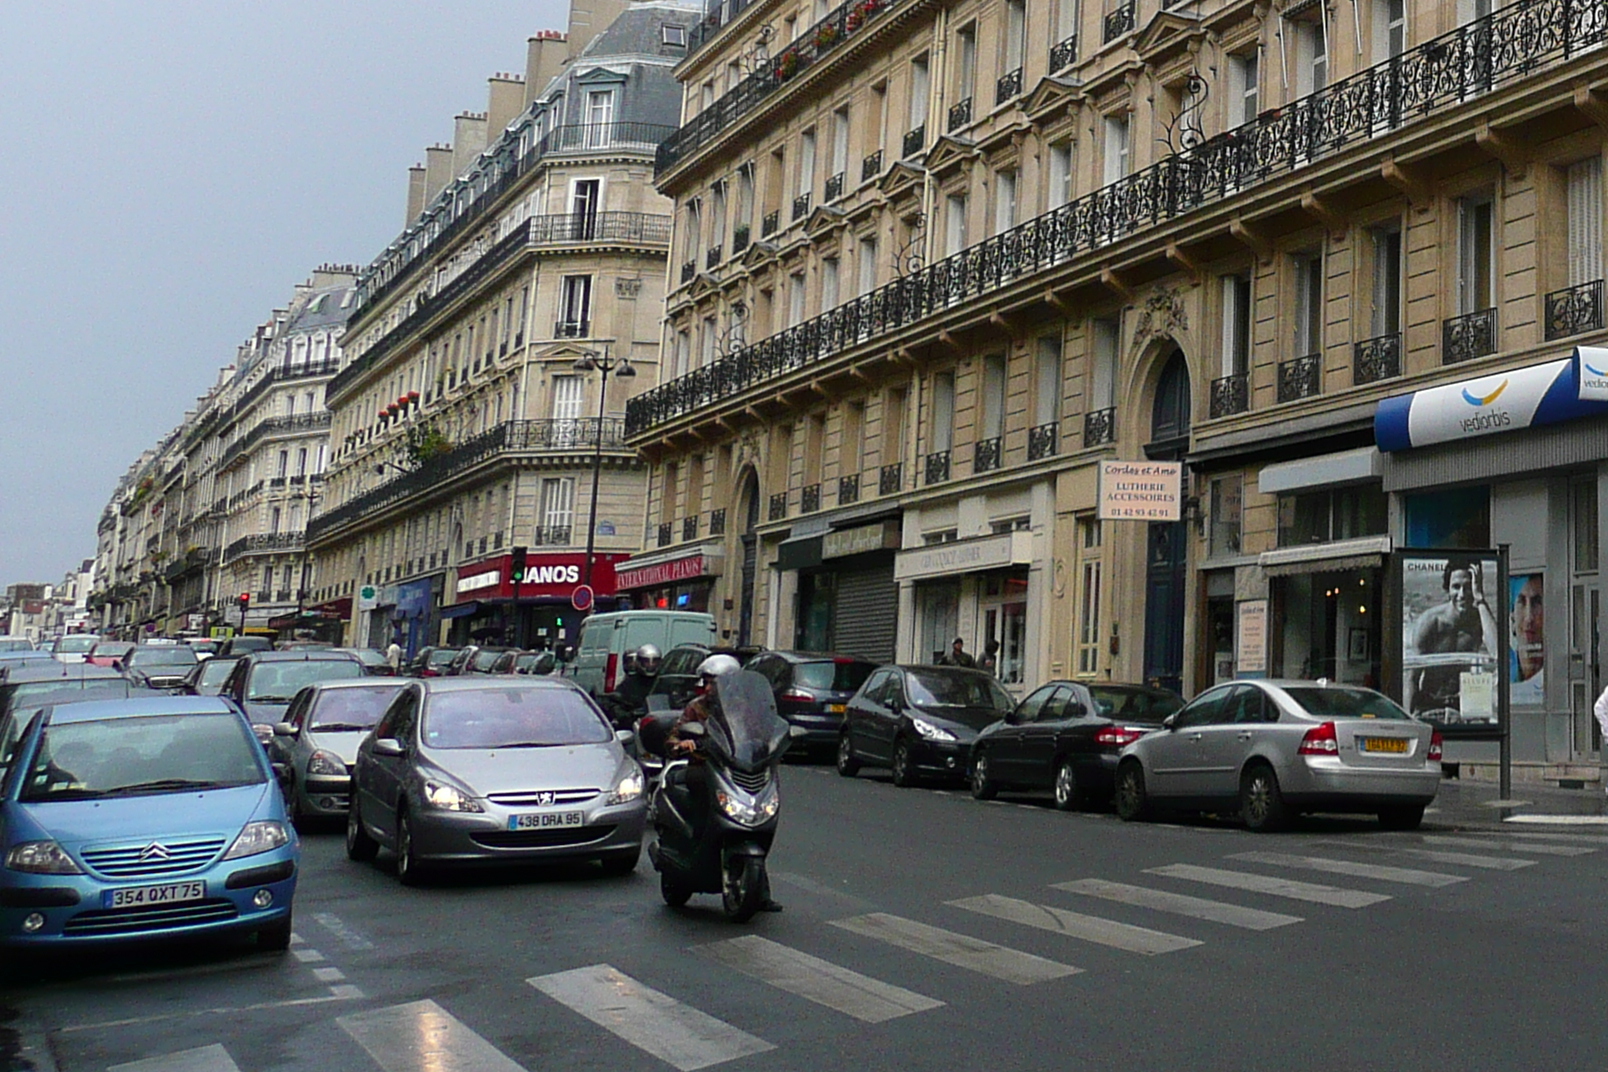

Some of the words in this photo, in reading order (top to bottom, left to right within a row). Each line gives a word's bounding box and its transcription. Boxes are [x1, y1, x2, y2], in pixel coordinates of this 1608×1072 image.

[1459, 408, 1511, 433] vediorbis
[1105, 464, 1139, 475] Cordes
[1141, 467, 1152, 475] et
[1116, 482, 1166, 491] LUTHERIE
[1107, 492, 1175, 502] ACCESSOIRES
[1111, 508, 1121, 516] 01
[617, 564, 672, 589] INTERNATIONAL
[672, 558, 700, 578] PIANOS
[1407, 563, 1445, 572] CHANEL
[509, 565, 580, 584] IANOS
[542, 814, 563, 827] DRA
[566, 813, 580, 825] 95
[115, 890, 144, 905] 354
[182, 883, 201, 898] 75
